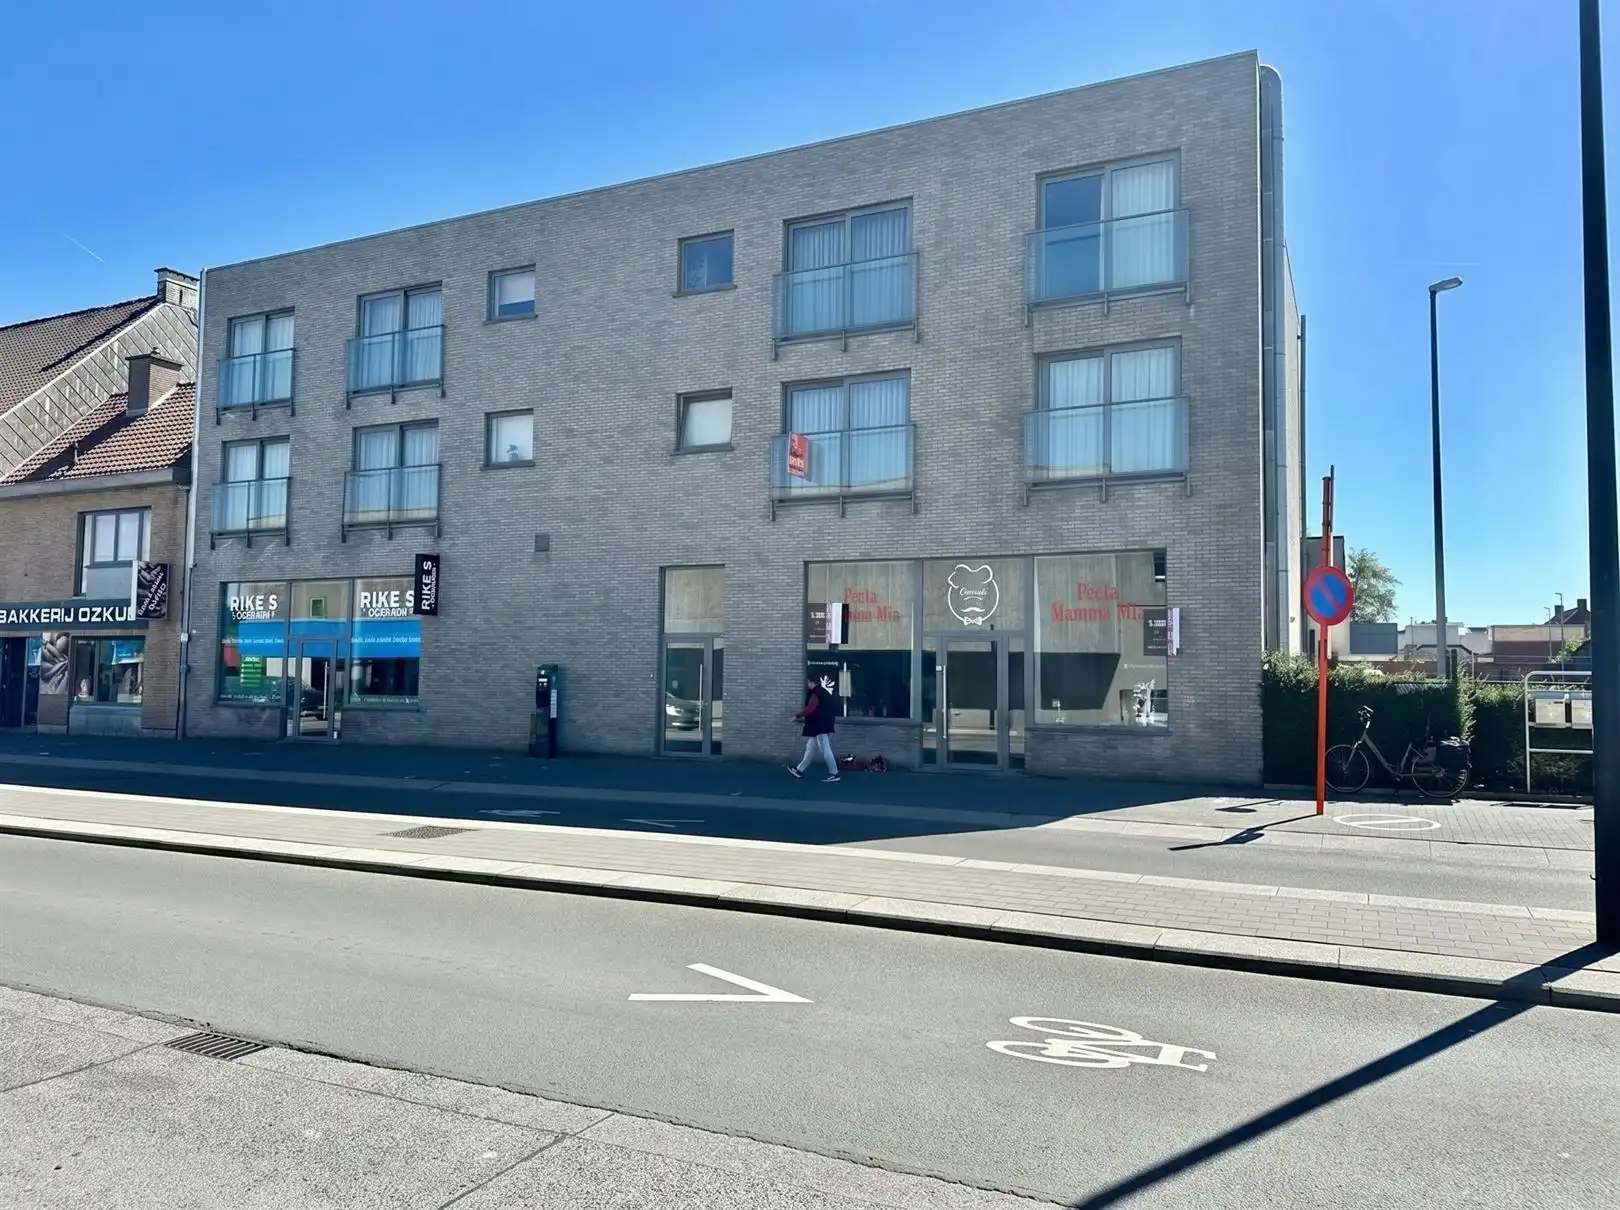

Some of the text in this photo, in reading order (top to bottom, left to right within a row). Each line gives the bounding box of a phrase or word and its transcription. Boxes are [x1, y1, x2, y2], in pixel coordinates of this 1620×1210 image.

[421, 560, 432, 610] RIKE S
[230, 594, 278, 611] RIKE S
[360, 590, 414, 608] RIKE S
[0, 608, 74, 623] BAKKERIJ
